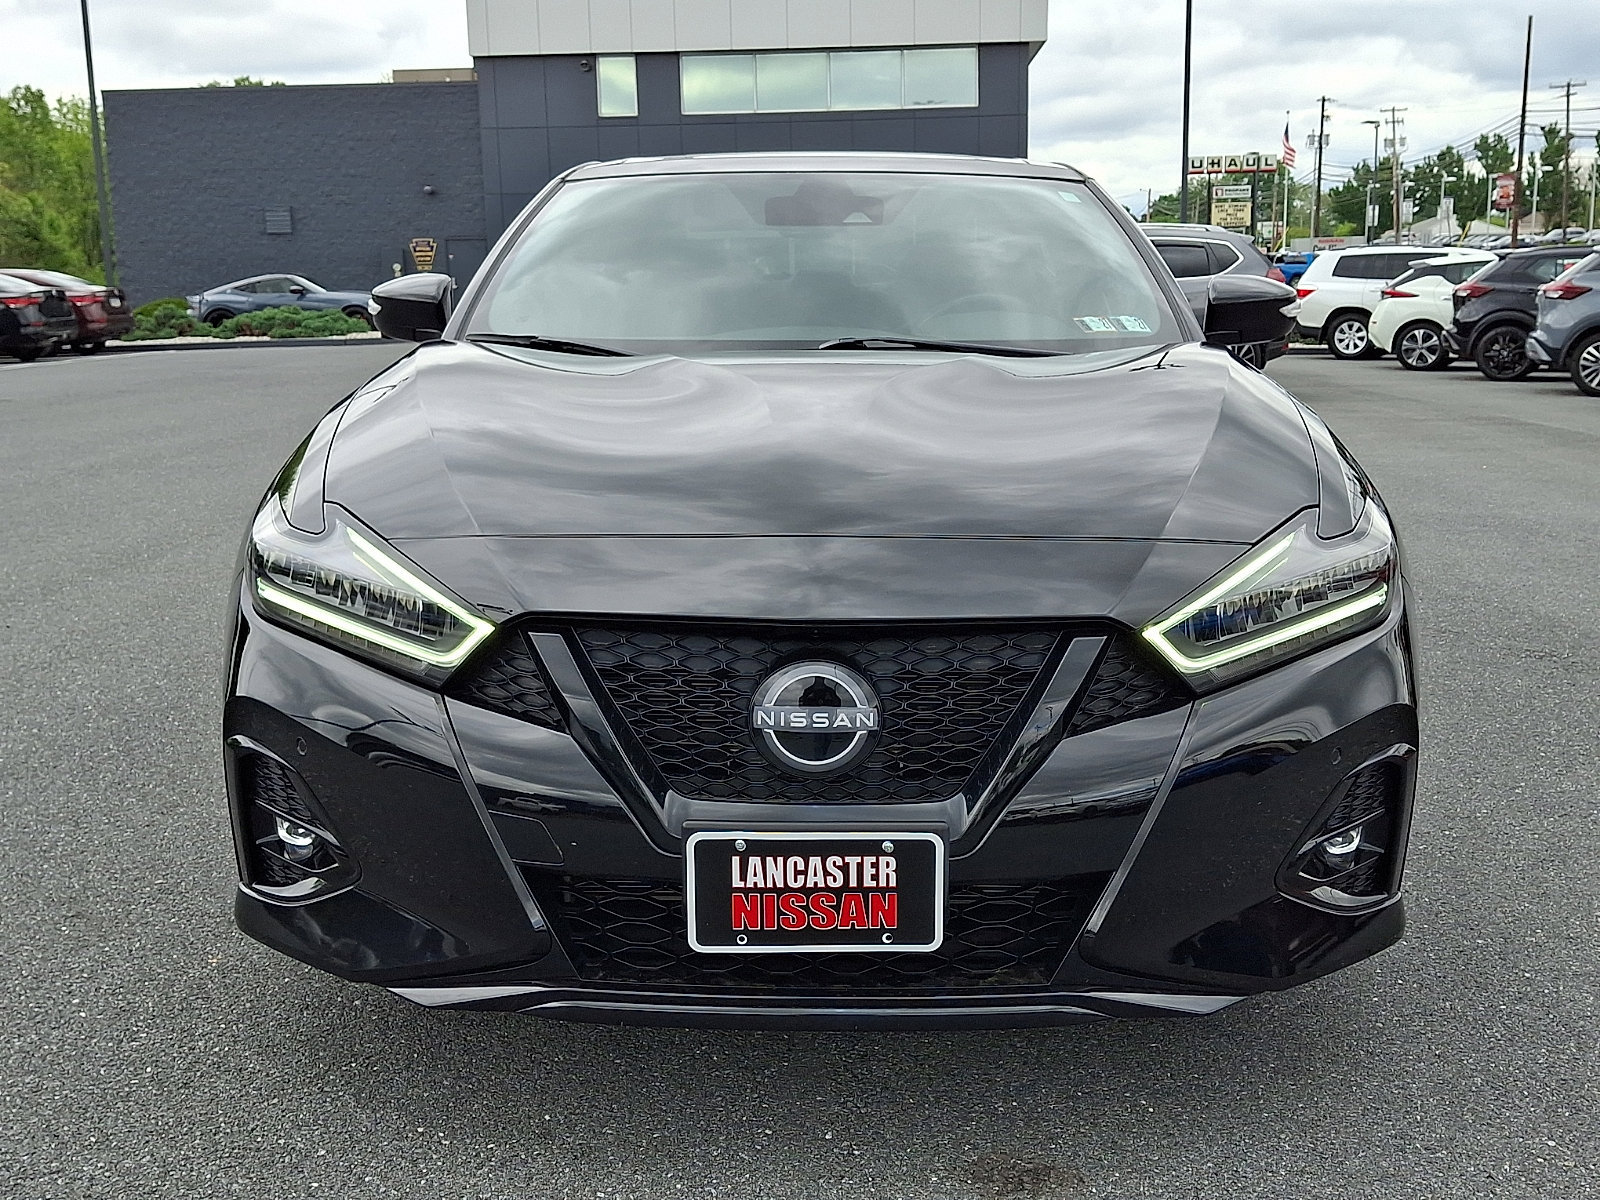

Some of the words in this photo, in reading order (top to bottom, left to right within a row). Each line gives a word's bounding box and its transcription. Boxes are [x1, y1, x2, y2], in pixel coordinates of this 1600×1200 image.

[757, 710, 874, 728] NISSAN
[731, 856, 898, 889] LANCASTER
[731, 892, 898, 931] NISSAN
